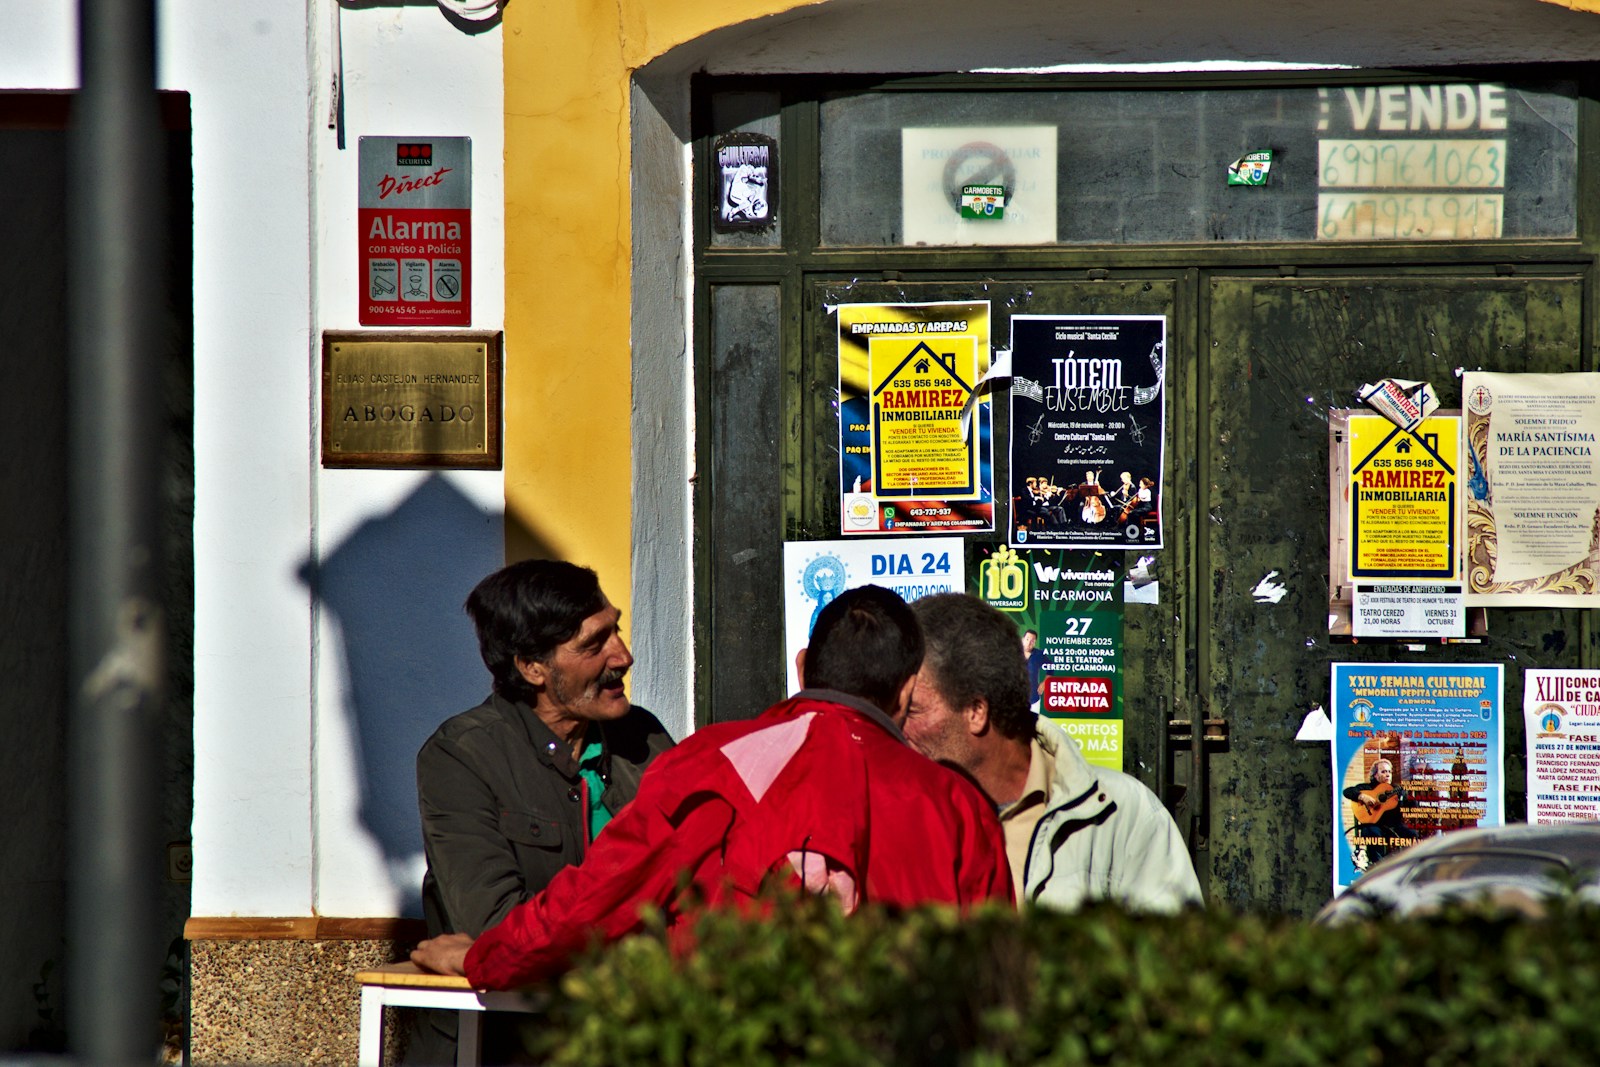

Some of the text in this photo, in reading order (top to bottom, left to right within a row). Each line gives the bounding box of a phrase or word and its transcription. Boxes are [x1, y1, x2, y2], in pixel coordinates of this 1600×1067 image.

[1344, 84, 1506, 130] VENDE
[1323, 143, 1501, 185] 699961063
[377, 166, 453, 200] Direct
[964, 186, 1002, 195] CARMOBETIS
[369, 216, 461, 240] Alarma
[369, 243, 461, 254] con aviso a Policía
[369, 306, 461, 314] 900 45 45 45 securitasdirect.es
[852, 321, 968, 334] EMPANADAS Y AREPAS
[1067, 332, 1085, 340] musical
[1052, 350, 1122, 389] TÓTEM
[337, 374, 480, 384] ELIAS CASTEJON HERNANDEZ
[894, 378, 952, 388] 635 856 948
[883, 390, 963, 408] RAMIREZ
[1045, 386, 1132, 413] ENSEMBLE
[1386, 383, 1419, 418] RAMIREZ
[1380, 389, 1412, 423] INMOBILIARIA
[344, 404, 474, 422] ABOGADO
[882, 410, 963, 422] INMOBILIARIA
[1497, 431, 1595, 442] MARÍA SANTÍSIMA
[1500, 447, 1591, 456] DE LA PACIENCIA
[1362, 471, 1445, 488] RAMIREZ
[1360, 492, 1446, 501] INMOBILIARIA
[872, 552, 950, 575] DIA 24
[1061, 570, 1114, 580] vivamóvil
[986, 566, 1023, 599] 10
[1035, 590, 1113, 601] EN CARMONA
[1066, 618, 1093, 635] 27
[1072, 664, 1115, 673] (CARMONA)
[1050, 682, 1108, 694] ENTRADA
[1349, 676, 1486, 688] XXIV SEMANA CULTURAL
[1401, 689, 1431, 697] PEPITA
[1536, 677, 1564, 701] XLII
[1049, 697, 1109, 708] GRATUITA
[1566, 691, 1581, 702] DE
[1061, 724, 1118, 736] SORTEOS
[1424, 730, 1458, 738] Noviembre
[1470, 730, 1487, 738] 2025
[1088, 736, 1118, 751] MÁS
[1353, 837, 1388, 845] MANUEL
